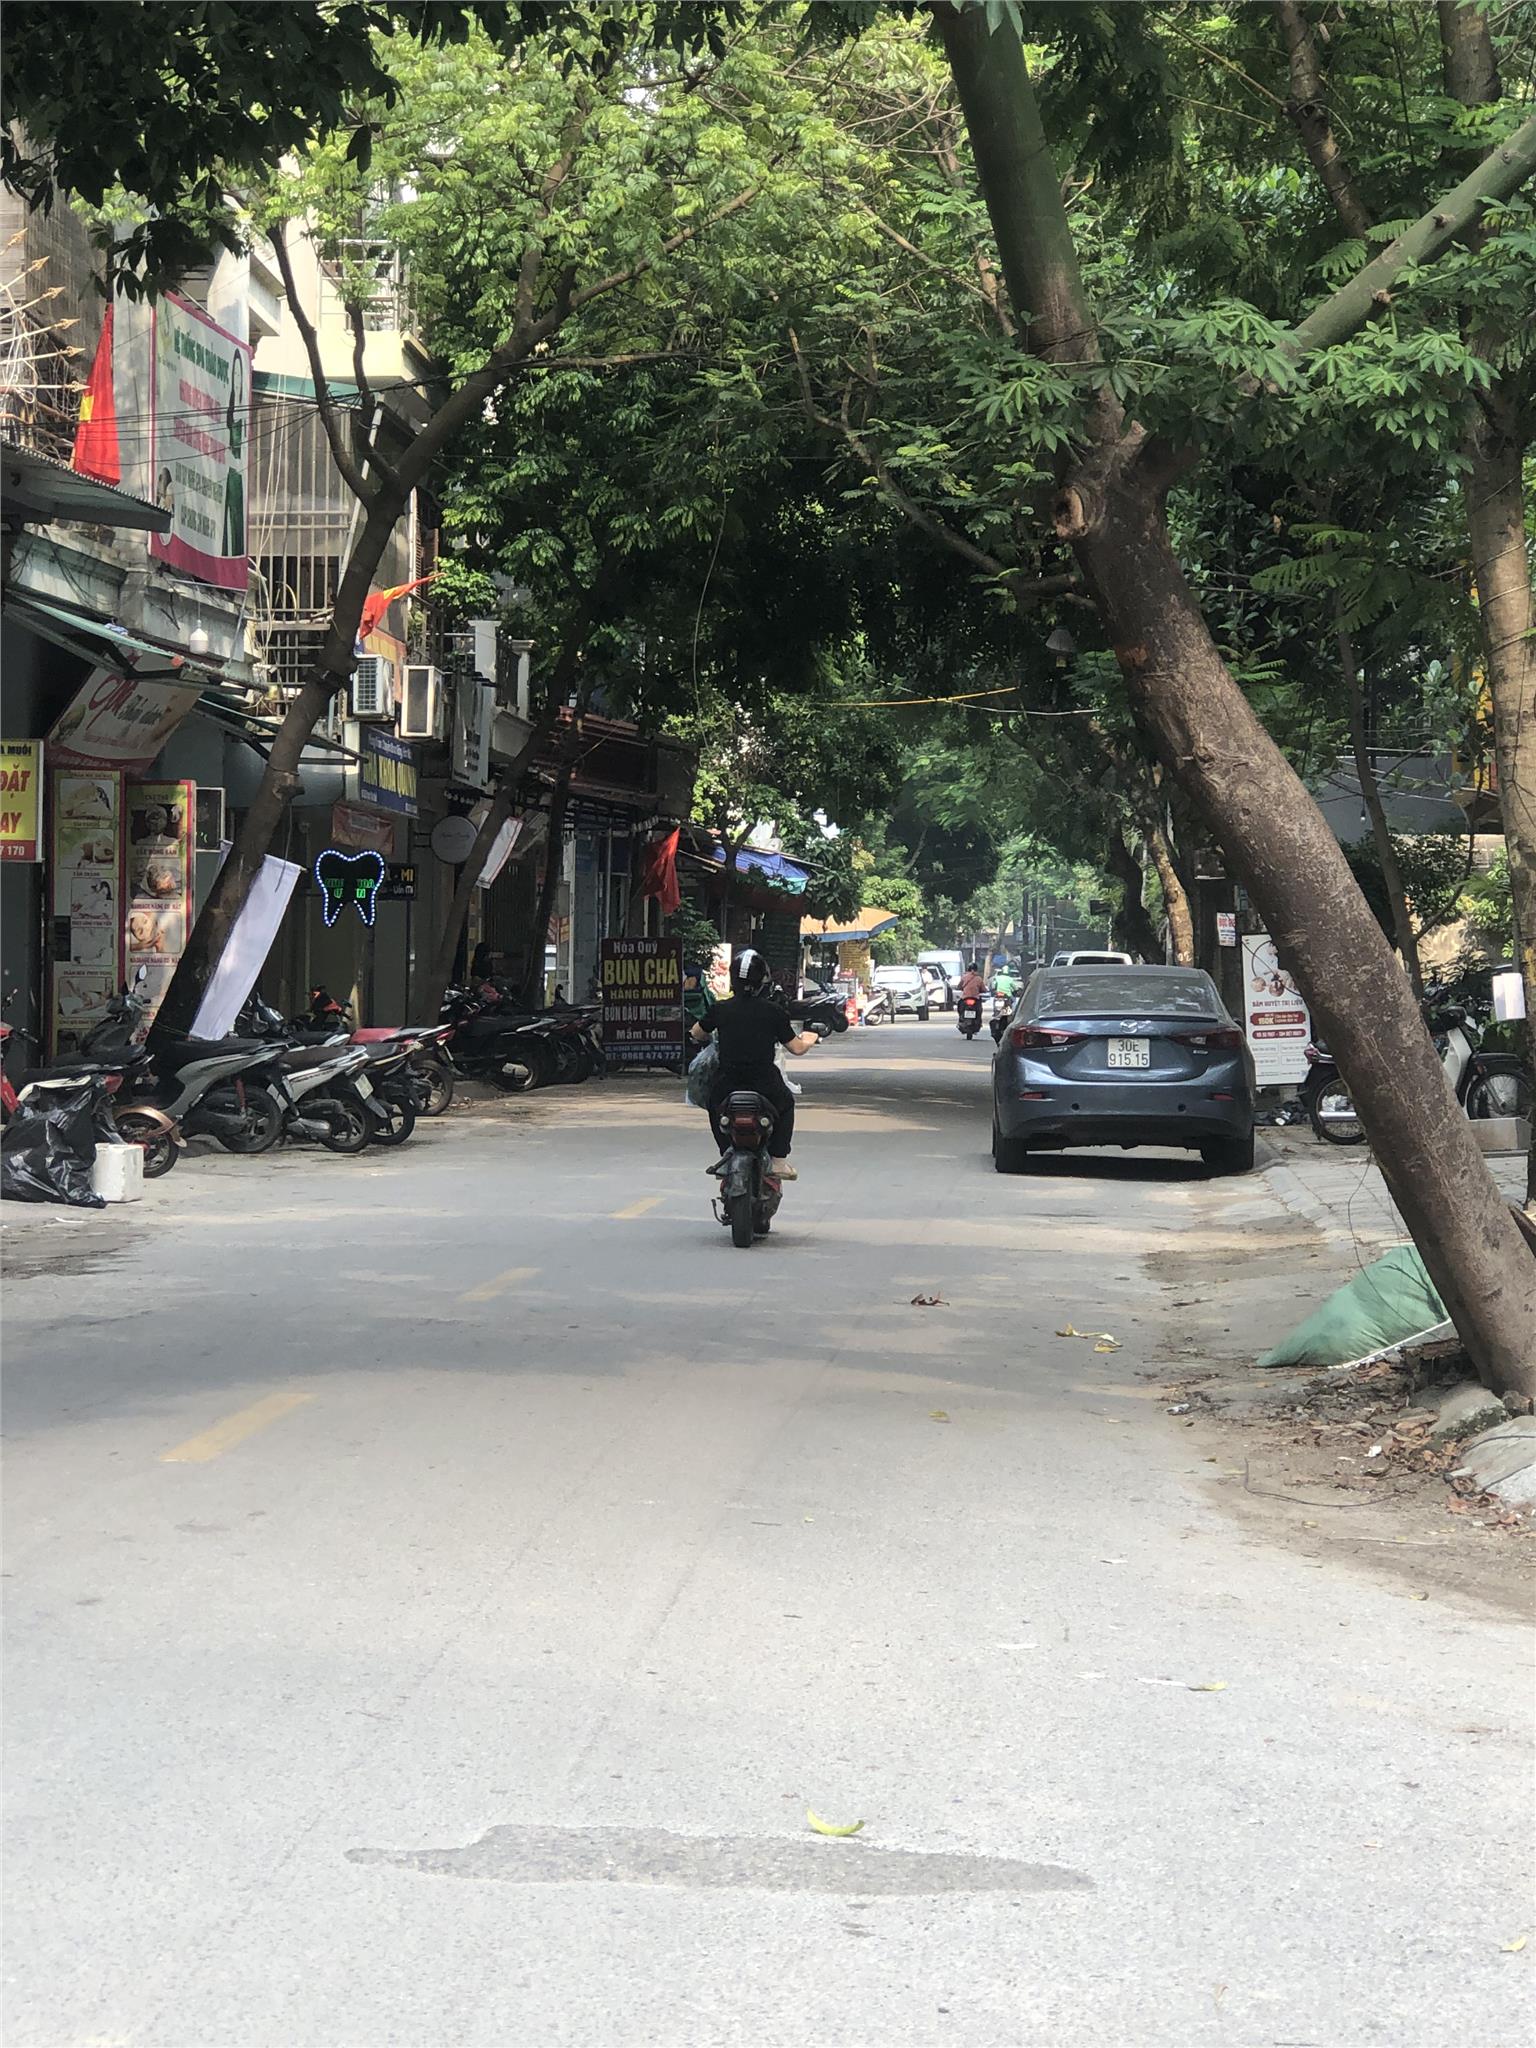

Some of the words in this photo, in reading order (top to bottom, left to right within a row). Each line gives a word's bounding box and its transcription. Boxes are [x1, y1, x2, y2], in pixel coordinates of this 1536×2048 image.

[8, 846, 25, 856] 170
[604, 954, 640, 986] BÚN
[644, 949, 680, 985] CHẢ
[604, 1002, 621, 1022] BÚN
[622, 1002, 639, 1024] ĐẬU
[1118, 1039, 1140, 1052] 30E
